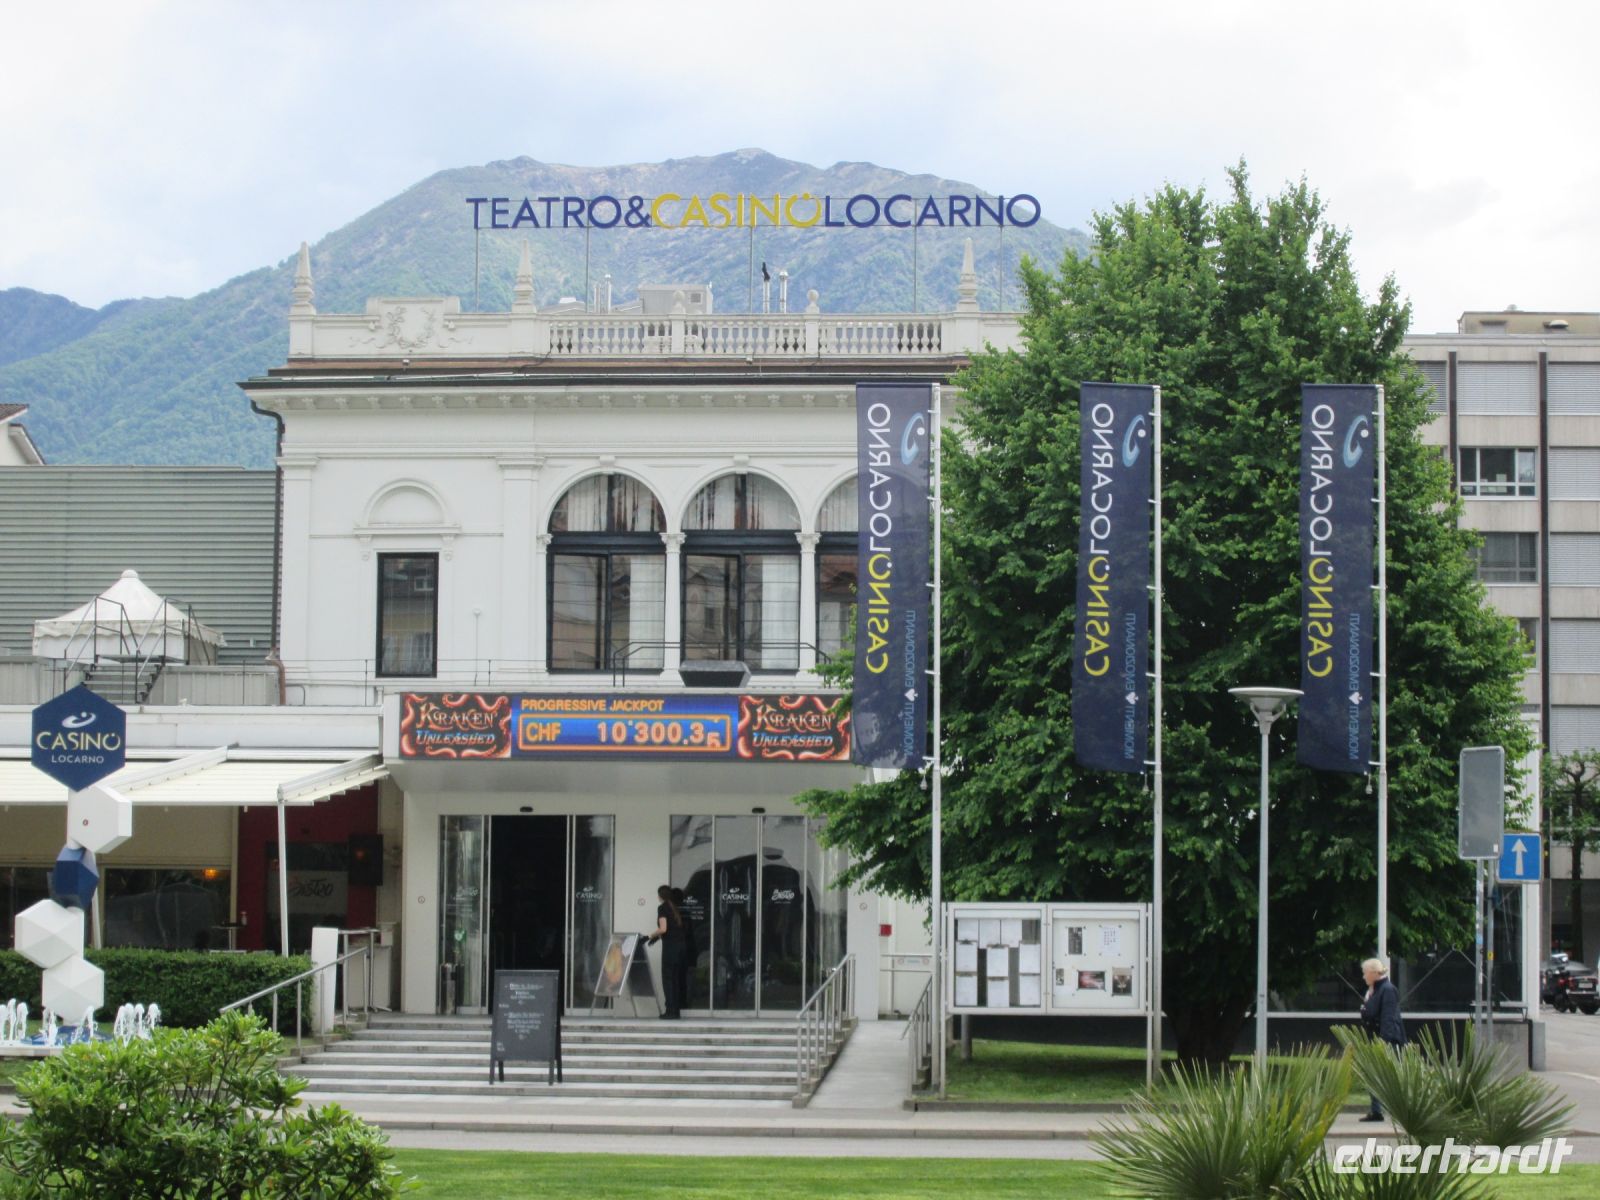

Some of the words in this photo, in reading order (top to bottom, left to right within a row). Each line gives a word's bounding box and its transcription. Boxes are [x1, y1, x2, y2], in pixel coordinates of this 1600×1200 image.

[521, 699, 606, 711] PROGRESSIVE
[609, 700, 664, 711] JACKPOT
[416, 730, 495, 746] UNLEASHED
[526, 722, 561, 741] CHF
[36, 731, 121, 751] CASINO
[752, 732, 833, 747] UNLEASHED
[51, 755, 104, 764] LOCARNO
